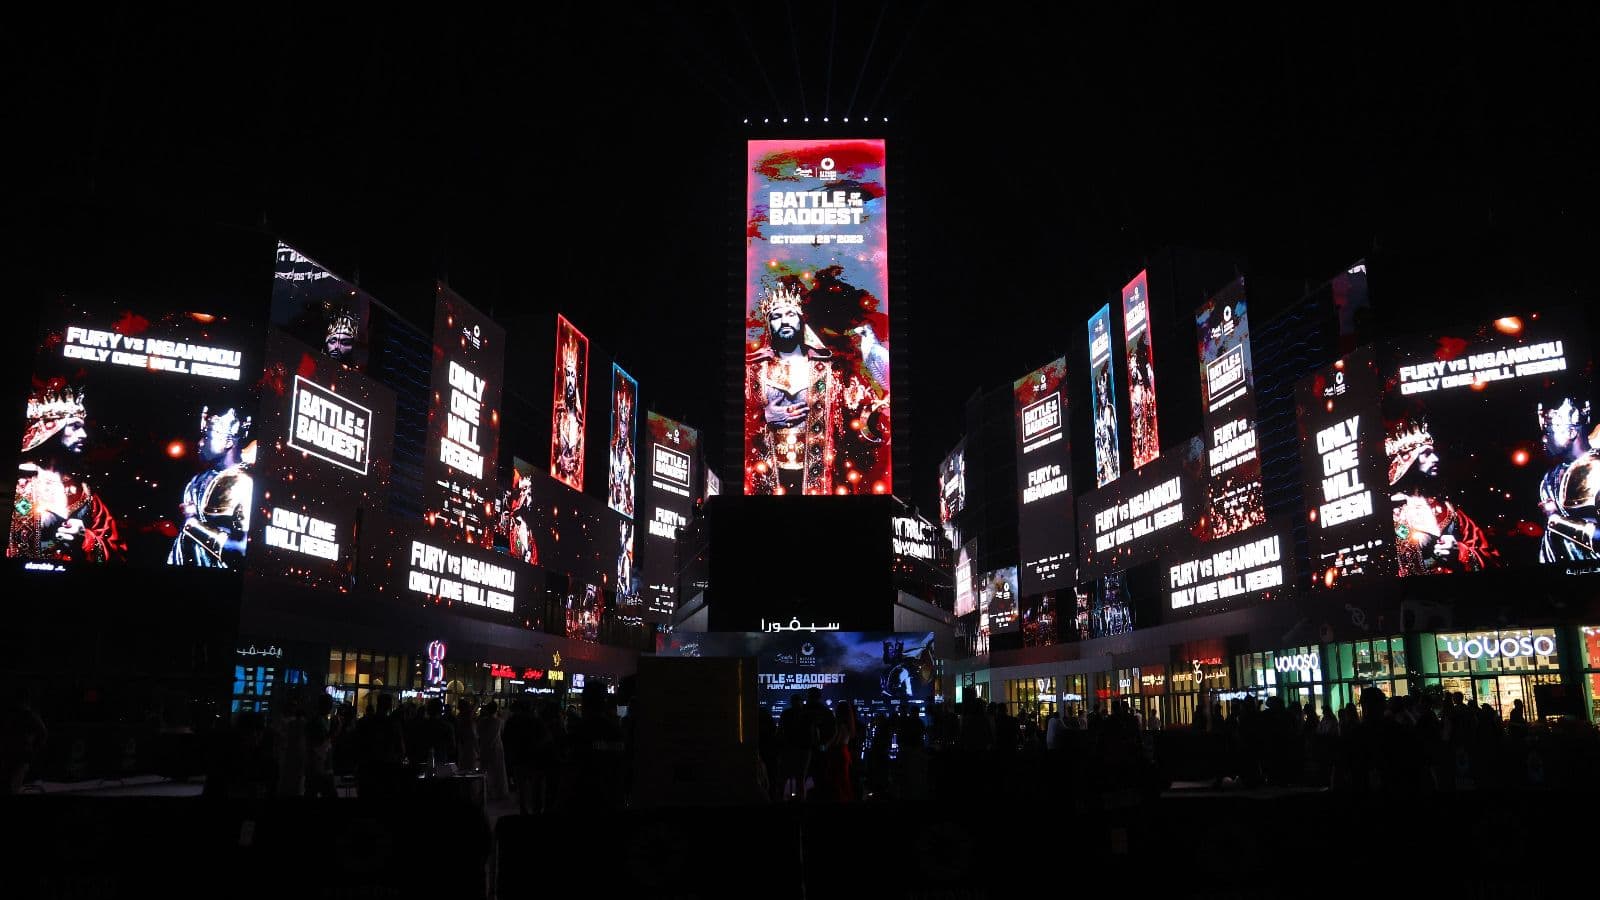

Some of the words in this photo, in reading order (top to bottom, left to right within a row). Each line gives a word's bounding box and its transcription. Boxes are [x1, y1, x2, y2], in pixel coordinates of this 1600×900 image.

[769, 191, 846, 208] BATTLE
[769, 208, 864, 225] BADDEST
[770, 234, 816, 244] OCTOBER
[63, 344, 111, 362] ONLY
[111, 351, 148, 368] ONE
[149, 356, 189, 374] WILL
[66, 326, 123, 349] FURY
[146, 338, 242, 367] NGANNOU
[1399, 360, 1447, 382] FURY
[1468, 340, 1564, 371] NGANNOU
[448, 360, 486, 403] ONLY
[1400, 377, 1440, 396] ONLY
[1441, 372, 1474, 389] ONE
[1474, 367, 1515, 384] WILL
[299, 389, 355, 436] BATTLE
[450, 388, 481, 427] ONE
[296, 414, 365, 463] BADDEST
[447, 412, 480, 453] WILL
[1209, 429, 1256, 467] NGANNOU
[1213, 419, 1238, 447] FURY
[1316, 414, 1360, 455] ONLY
[440, 436, 484, 480] REIGN
[1027, 464, 1052, 488] FURY
[1322, 440, 1360, 477] ONE
[1023, 474, 1068, 505] NGANNOU
[1321, 468, 1365, 502] WILL
[655, 507, 678, 526] FURY
[1095, 505, 1119, 534] FURY
[1128, 476, 1182, 520] NGANNOU
[1319, 490, 1373, 529] REIGN
[265, 525, 299, 552] WILL
[272, 507, 310, 534] ONLY
[309, 517, 337, 542] ONE
[1095, 532, 1116, 553] ONLY
[1115, 524, 1134, 546] ONE
[1132, 516, 1155, 541] WILL
[410, 540, 448, 574] FURY
[447, 554, 460, 575] VS
[460, 556, 516, 593] NGANNOU
[1170, 559, 1199, 589] FURY
[1199, 558, 1213, 578] VS
[1212, 534, 1281, 577] NGANNOU
[408, 570, 440, 596] ONLY
[440, 578, 463, 601] ONE
[463, 584, 487, 607] WILL
[1171, 589, 1197, 610] ONLY
[1196, 582, 1219, 604] ONE
[1217, 575, 1245, 599] WILL
[1244, 565, 1283, 593] REIGN
[761, 616, 840, 633] سيفورا
[758, 673, 786, 684] TTLE
[795, 673, 846, 684] BADDEST
